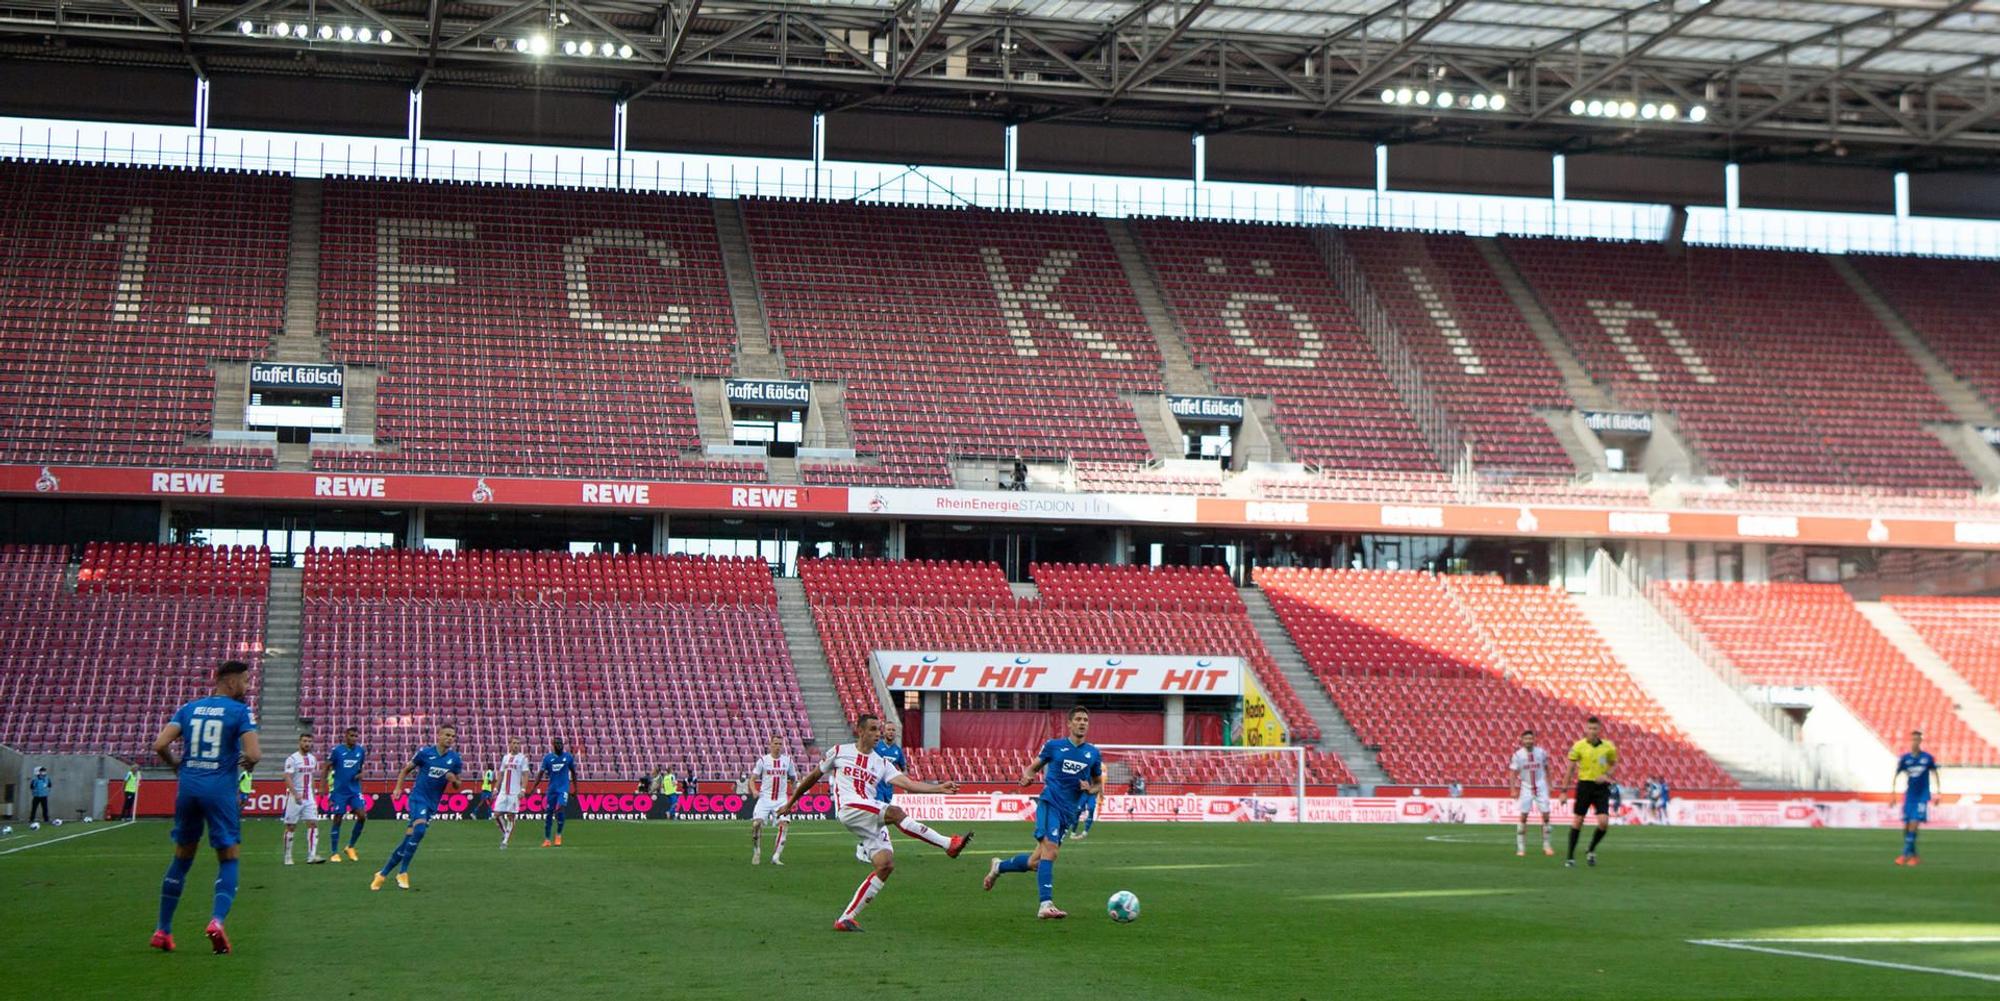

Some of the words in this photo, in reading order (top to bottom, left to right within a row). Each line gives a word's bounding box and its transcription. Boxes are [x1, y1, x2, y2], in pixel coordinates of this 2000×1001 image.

[92, 206, 211, 324] 1.
[376, 217, 691, 342] FC
[979, 246, 1717, 384] Köln
[252, 366, 294, 384] Gaffel
[295, 367, 342, 386] Kölsch
[766, 384, 809, 402] Kölsch
[1202, 400, 1243, 418] Kölsch
[152, 473, 225, 493] REWE
[315, 476, 386, 497] REWE
[582, 483, 650, 504] REWE
[732, 487, 798, 508] REWE
[886, 665, 956, 687] HIT
[978, 666, 1047, 688] HIT
[1070, 668, 1138, 689] HIT
[1160, 669, 1229, 691] HIT
[190, 718, 224, 759] 19
[843, 766, 878, 785] REWE
[1063, 761, 1083, 772] SAP
[578, 794, 653, 812] weco
[903, 807, 944, 819] ATALOG
[948, 807, 992, 819] 2020/21
[583, 812, 647, 820] feuerwerk
